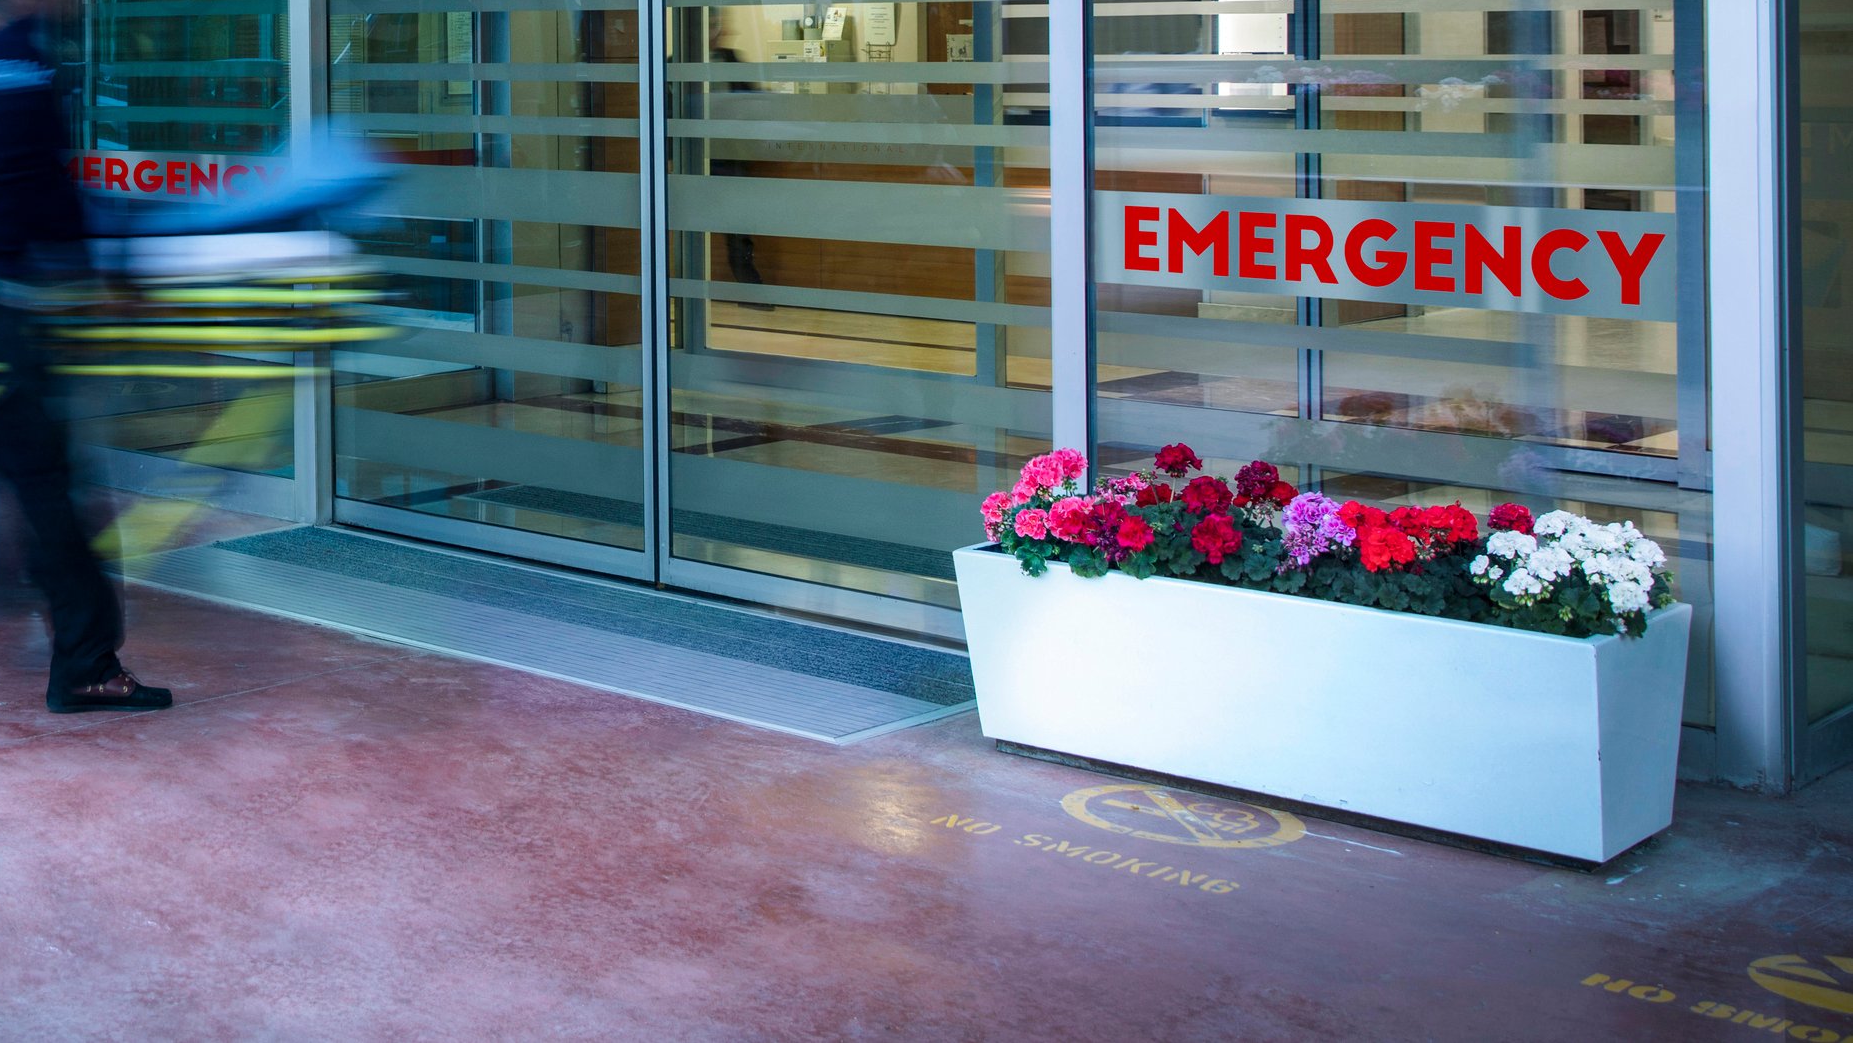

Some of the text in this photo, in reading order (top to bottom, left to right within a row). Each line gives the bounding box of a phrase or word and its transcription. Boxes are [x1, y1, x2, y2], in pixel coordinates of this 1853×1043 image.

[766, 141, 906, 154] INTERNATIONAL
[1123, 205, 1665, 306] EMERGENCY
[930, 813, 1241, 895] NO SMOKING
[1580, 972, 1853, 1043] NO SMO
